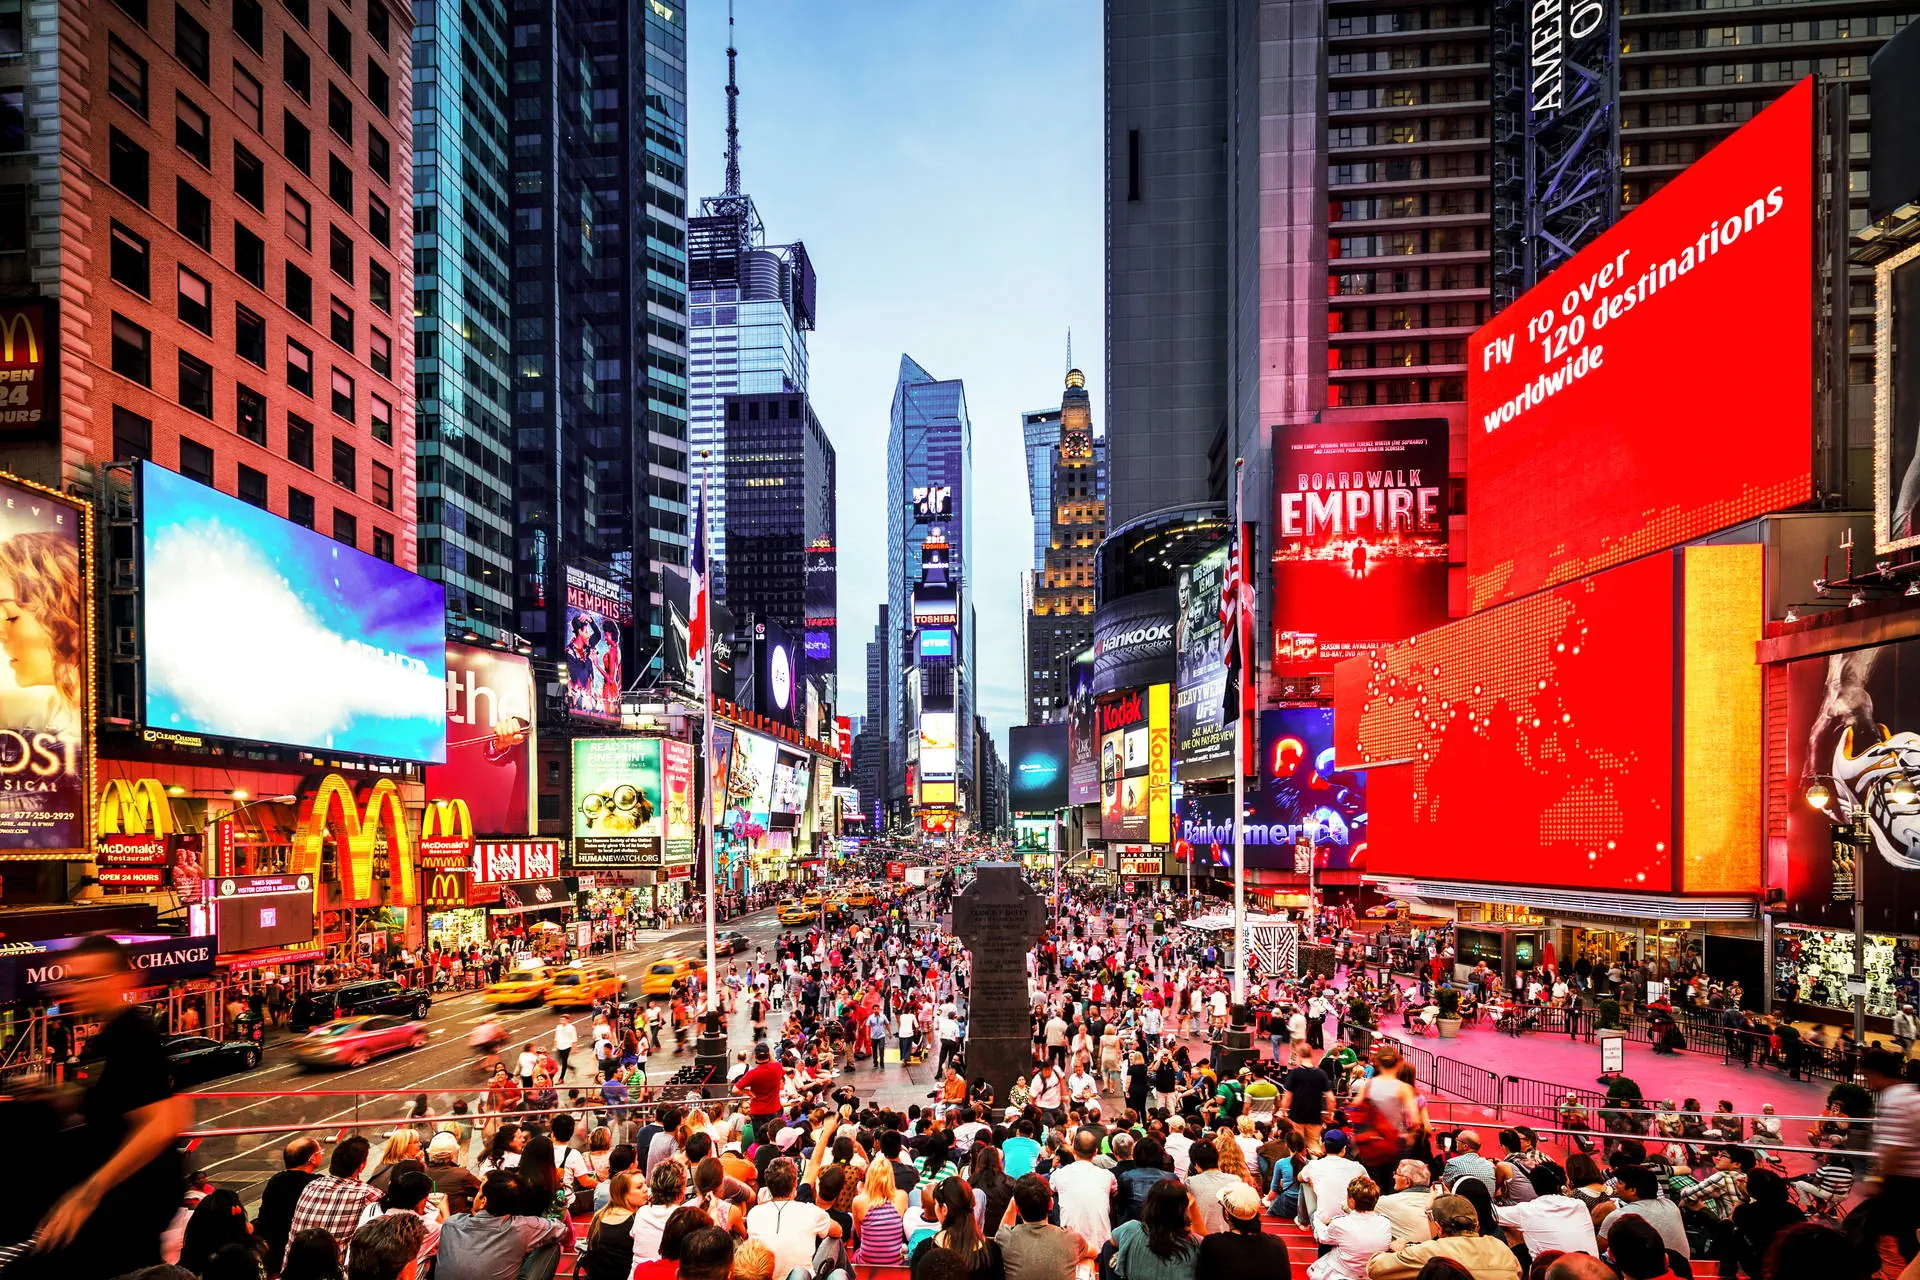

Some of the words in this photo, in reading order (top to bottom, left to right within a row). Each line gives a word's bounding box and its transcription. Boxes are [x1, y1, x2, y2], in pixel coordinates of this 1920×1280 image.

[1541, 314, 1585, 364] 120
[1592, 185, 1784, 330] destinations
[1483, 333, 1515, 372] Fly
[1528, 309, 1554, 342] to
[1561, 249, 1631, 316] over
[1483, 344, 1604, 434] worldwide
[1298, 469, 1422, 491] BOARDWALK
[1280, 486, 1442, 538] EMPIRE
[567, 574, 586, 588] BEST
[588, 581, 620, 601] MUSICAL
[567, 586, 620, 619] MEMPHIS
[914, 615, 956, 624] TOSHIBA
[1133, 639, 1172, 651] emotion
[1352, 642, 1379, 650] AVAILABLE
[1103, 692, 1144, 732] Kodak
[1196, 699, 1217, 720] UFC
[1203, 723, 1214, 736] MAY
[590, 742, 619, 752] READ
[622, 741, 645, 752] THE
[1181, 740, 1190, 751] LIVE
[1191, 738, 1200, 747] ON
[1201, 730, 1235, 747] PAY-PER-VIEW
[1151, 727, 1168, 802] Kodak
[14, 811, 75, 820] 877-250-2929
[1184, 819, 1216, 845] Bank
[1216, 817, 1232, 845] of
[98, 841, 164, 854] McDonald's
[421, 841, 470, 849] McDonald's
[578, 854, 659, 862] HUMANEWATCH.ORG
[1136, 862, 1160, 873] EVITA
